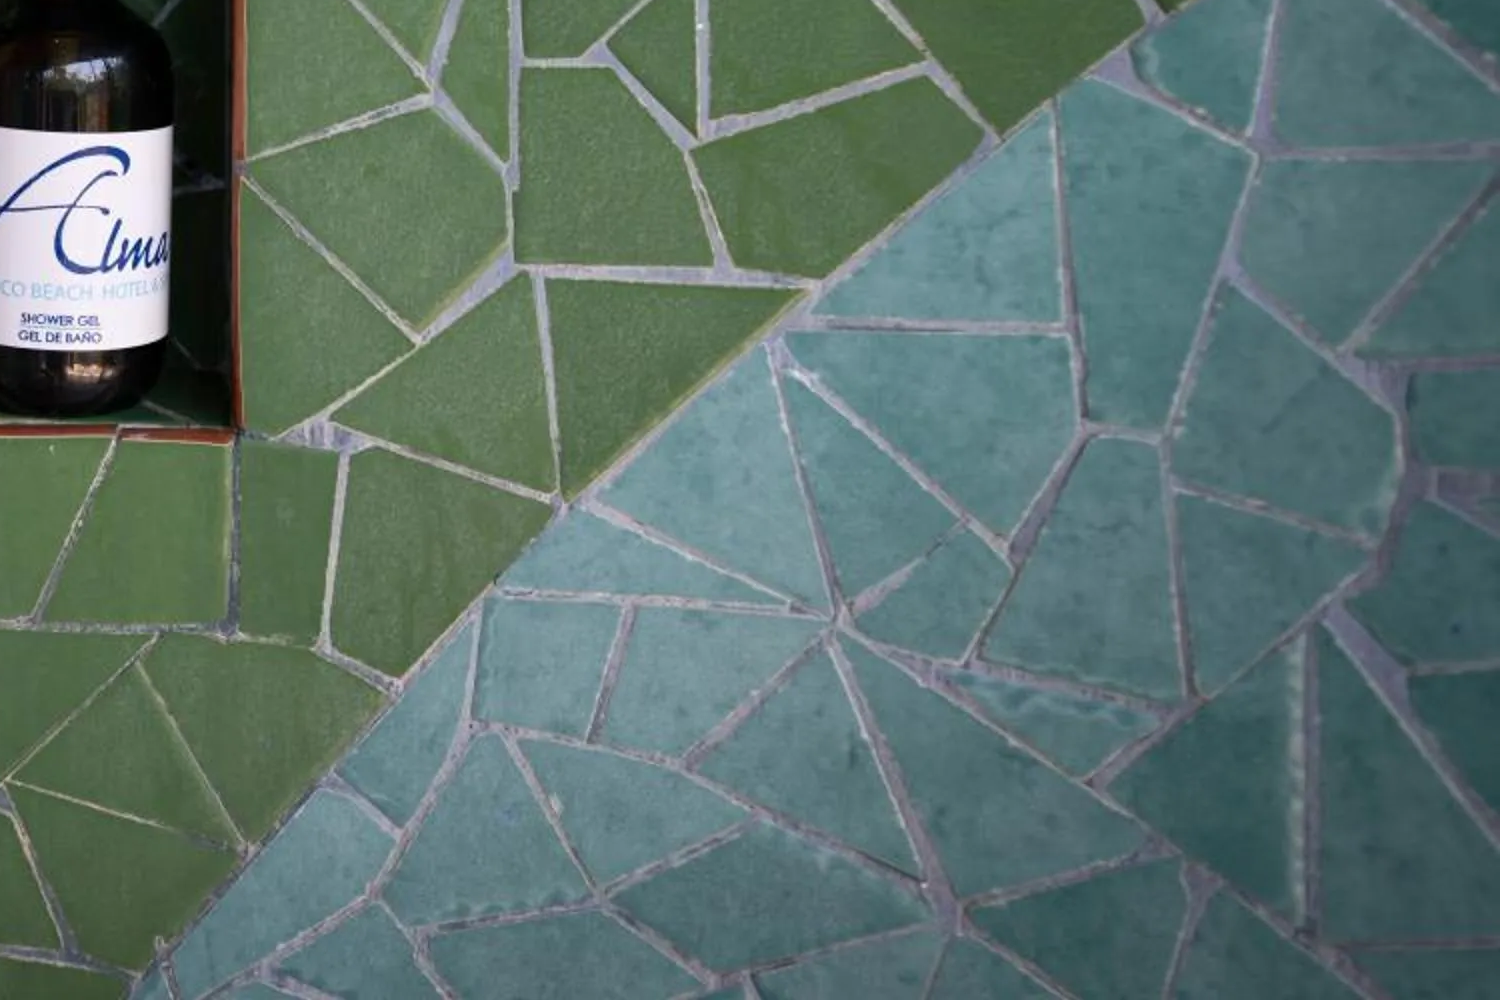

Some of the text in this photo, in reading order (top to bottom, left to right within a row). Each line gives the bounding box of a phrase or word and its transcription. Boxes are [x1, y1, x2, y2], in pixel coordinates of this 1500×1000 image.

[31, 281, 93, 301] BEACH
[102, 278, 149, 300] HOTEL
[20, 312, 101, 326] SHOWER GEL
[17, 329, 102, 344] GEL DE BAÑO
